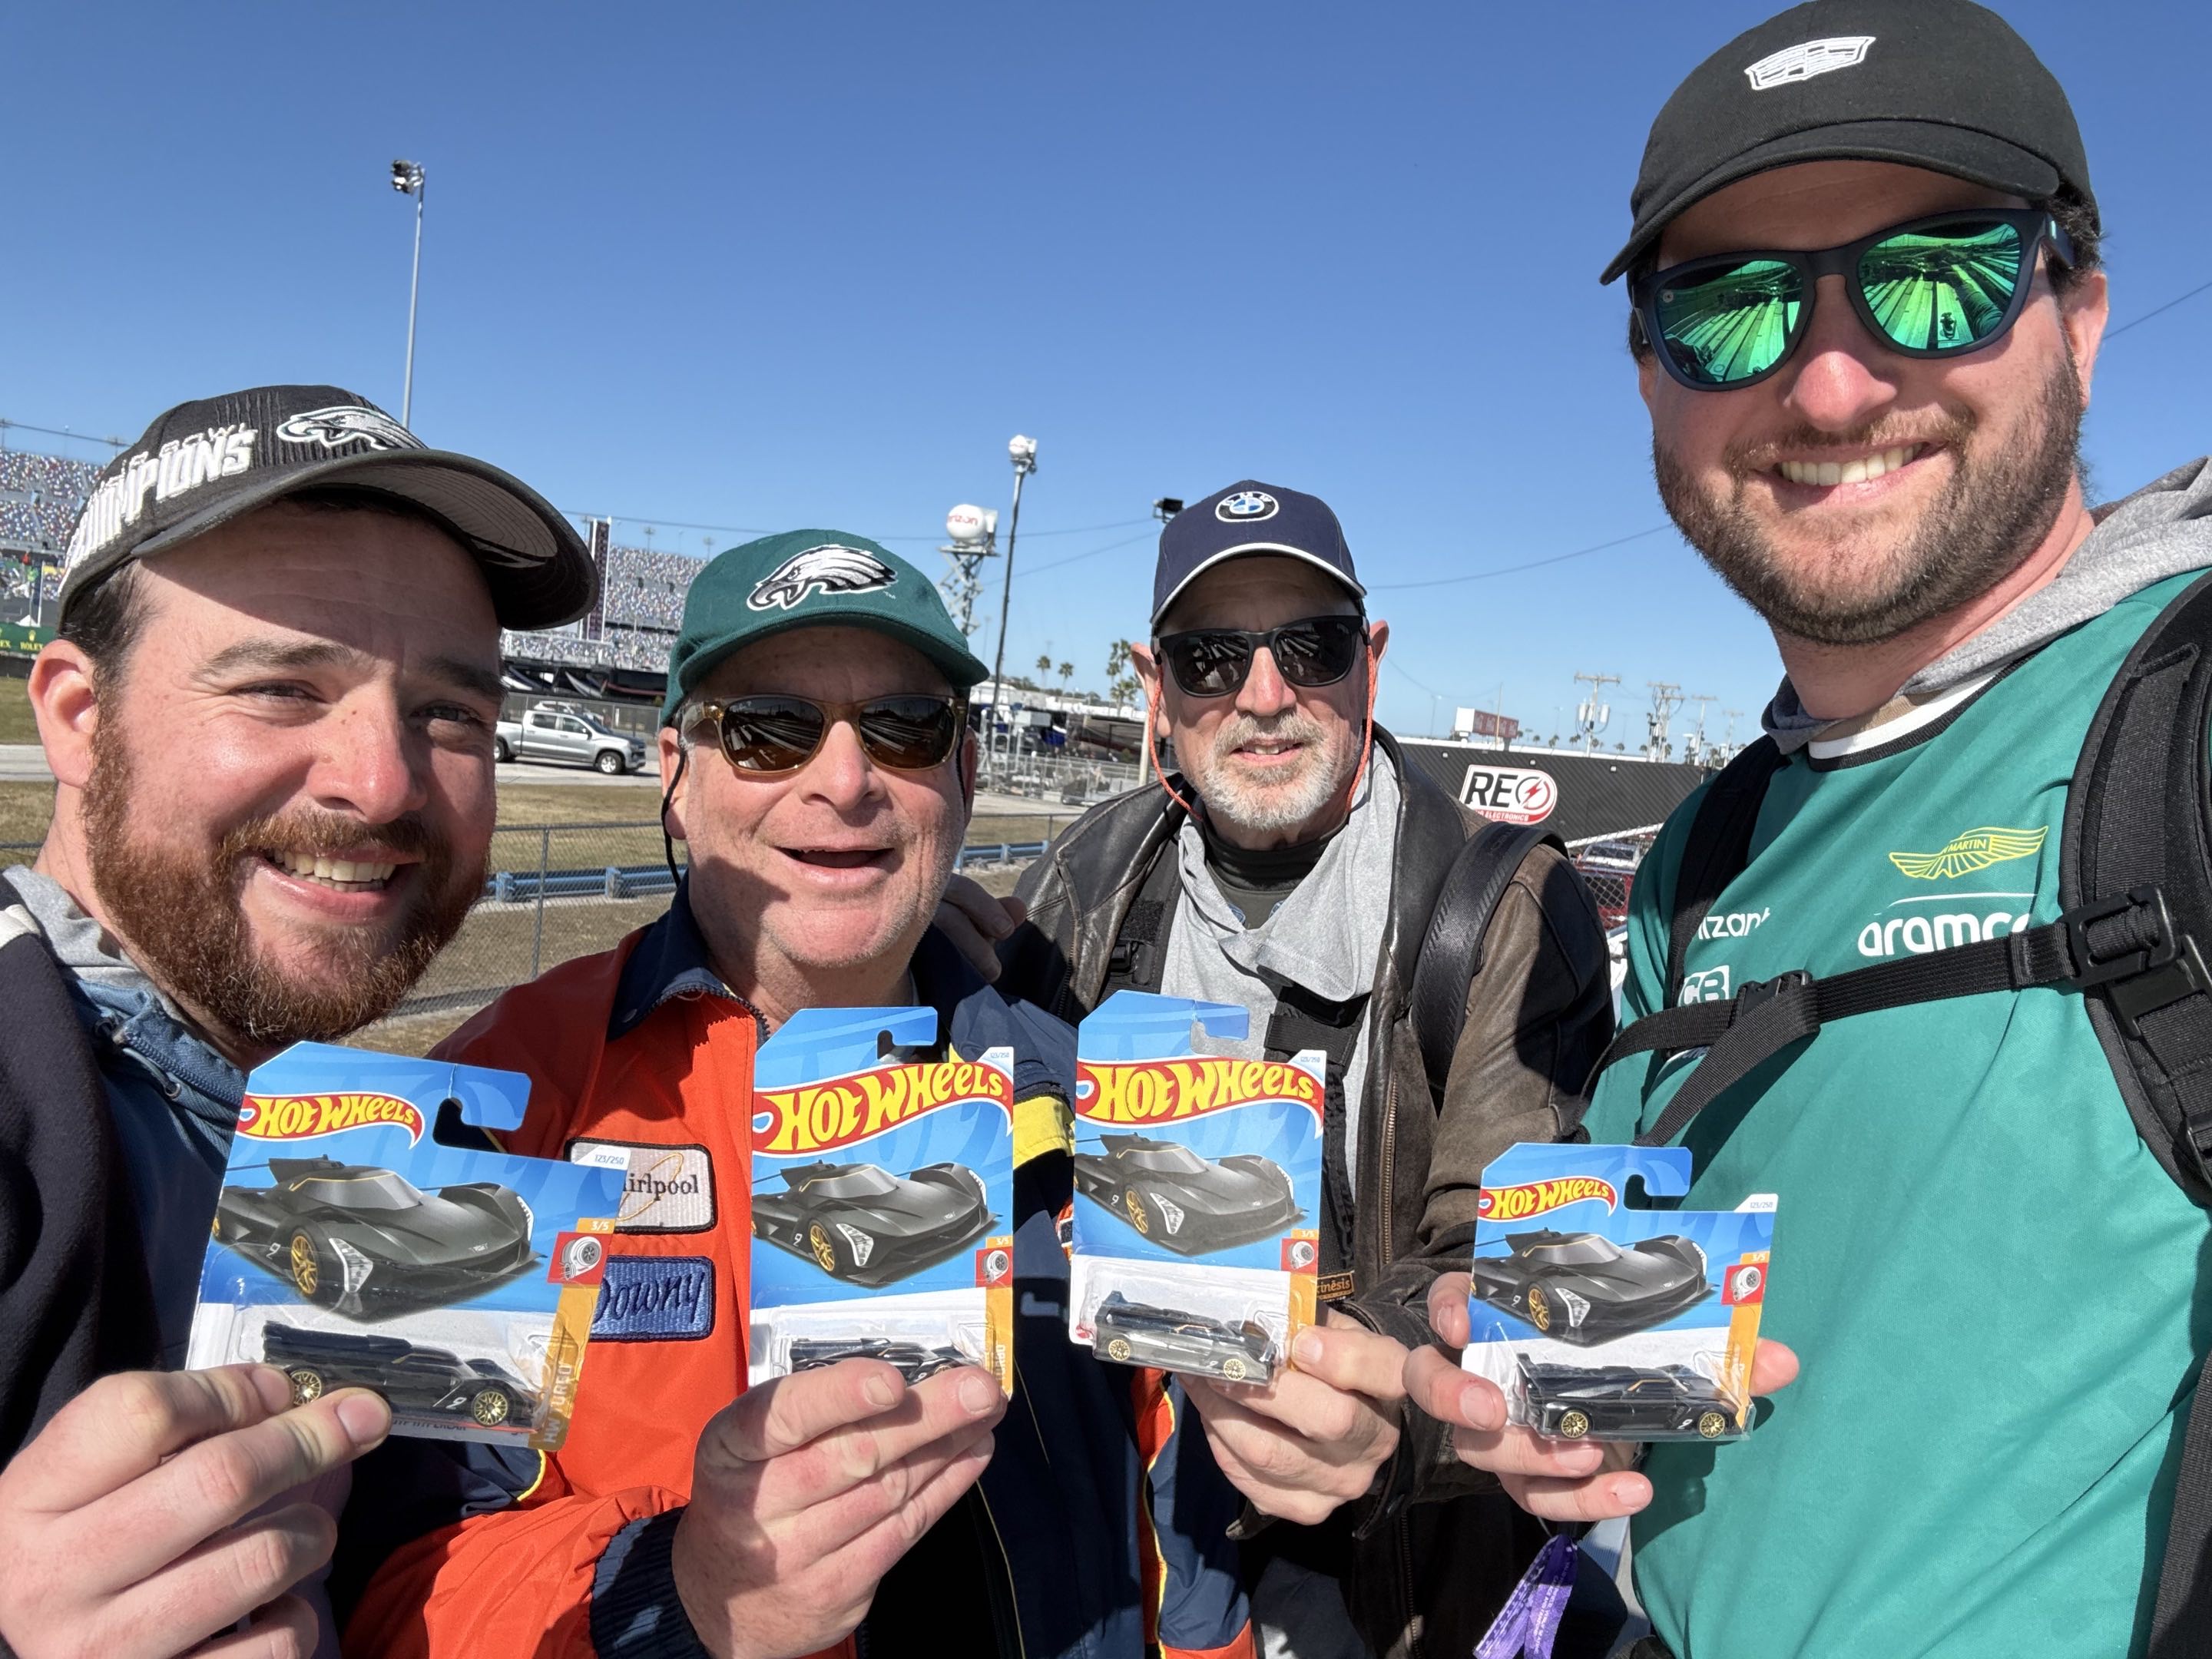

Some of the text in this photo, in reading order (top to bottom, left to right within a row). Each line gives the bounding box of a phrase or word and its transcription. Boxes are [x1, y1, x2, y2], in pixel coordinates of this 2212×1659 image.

[949, 515, 979, 526] rizon
[1948, 839, 1986, 851] MARTIN
[1858, 912, 2030, 957] aramc
[594, 1154, 625, 1165] 123/250
[624, 1173, 700, 1201] irlpool
[591, 1221, 610, 1231] 3/5
